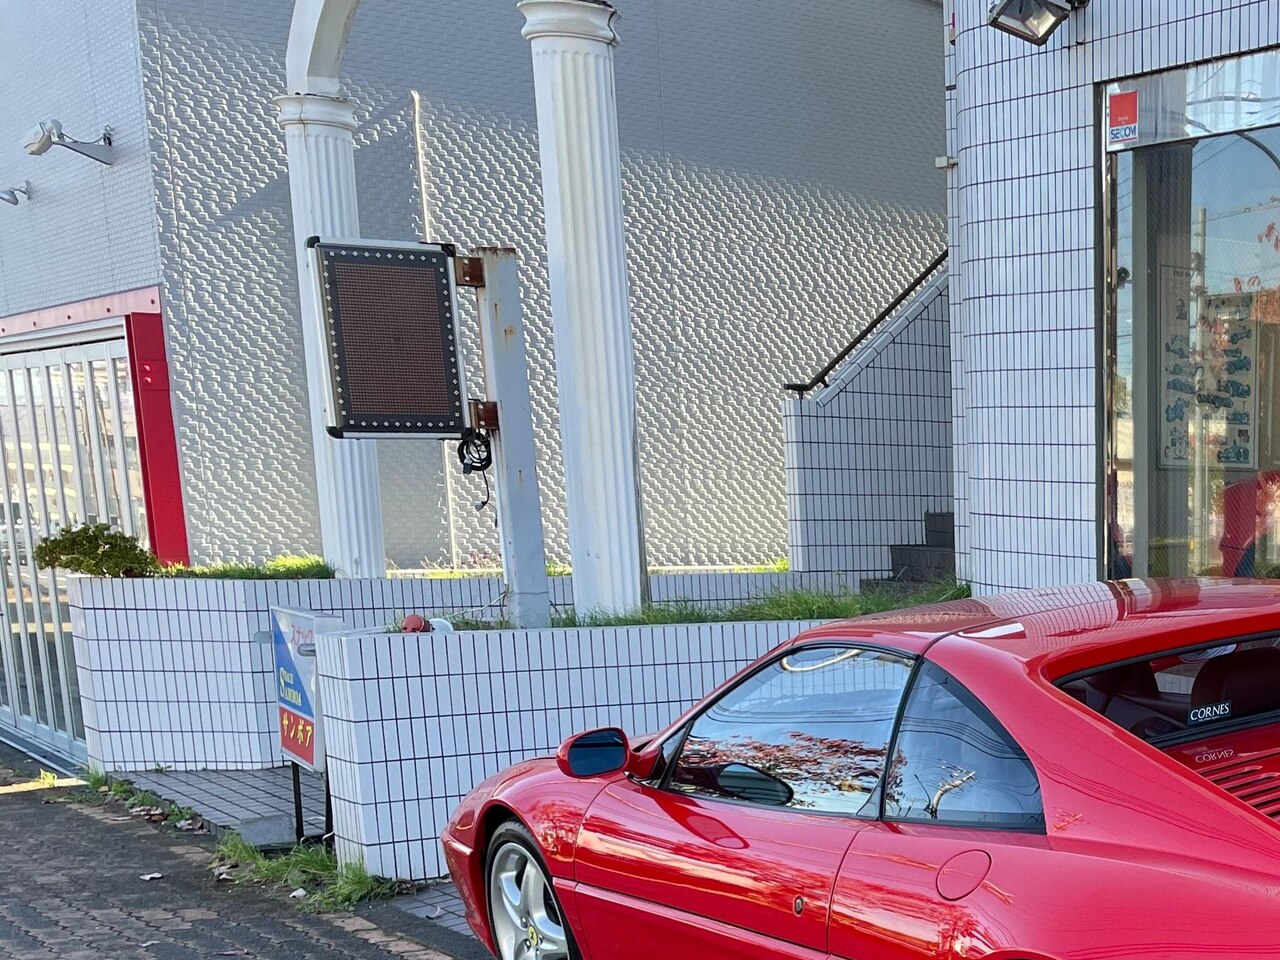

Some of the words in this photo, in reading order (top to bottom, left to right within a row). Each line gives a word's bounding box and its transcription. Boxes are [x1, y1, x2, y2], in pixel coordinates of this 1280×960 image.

[1110, 124, 1137, 140] SECOM
[1190, 702, 1230, 721] CORNES
[282, 711, 313, 748] サンボア
